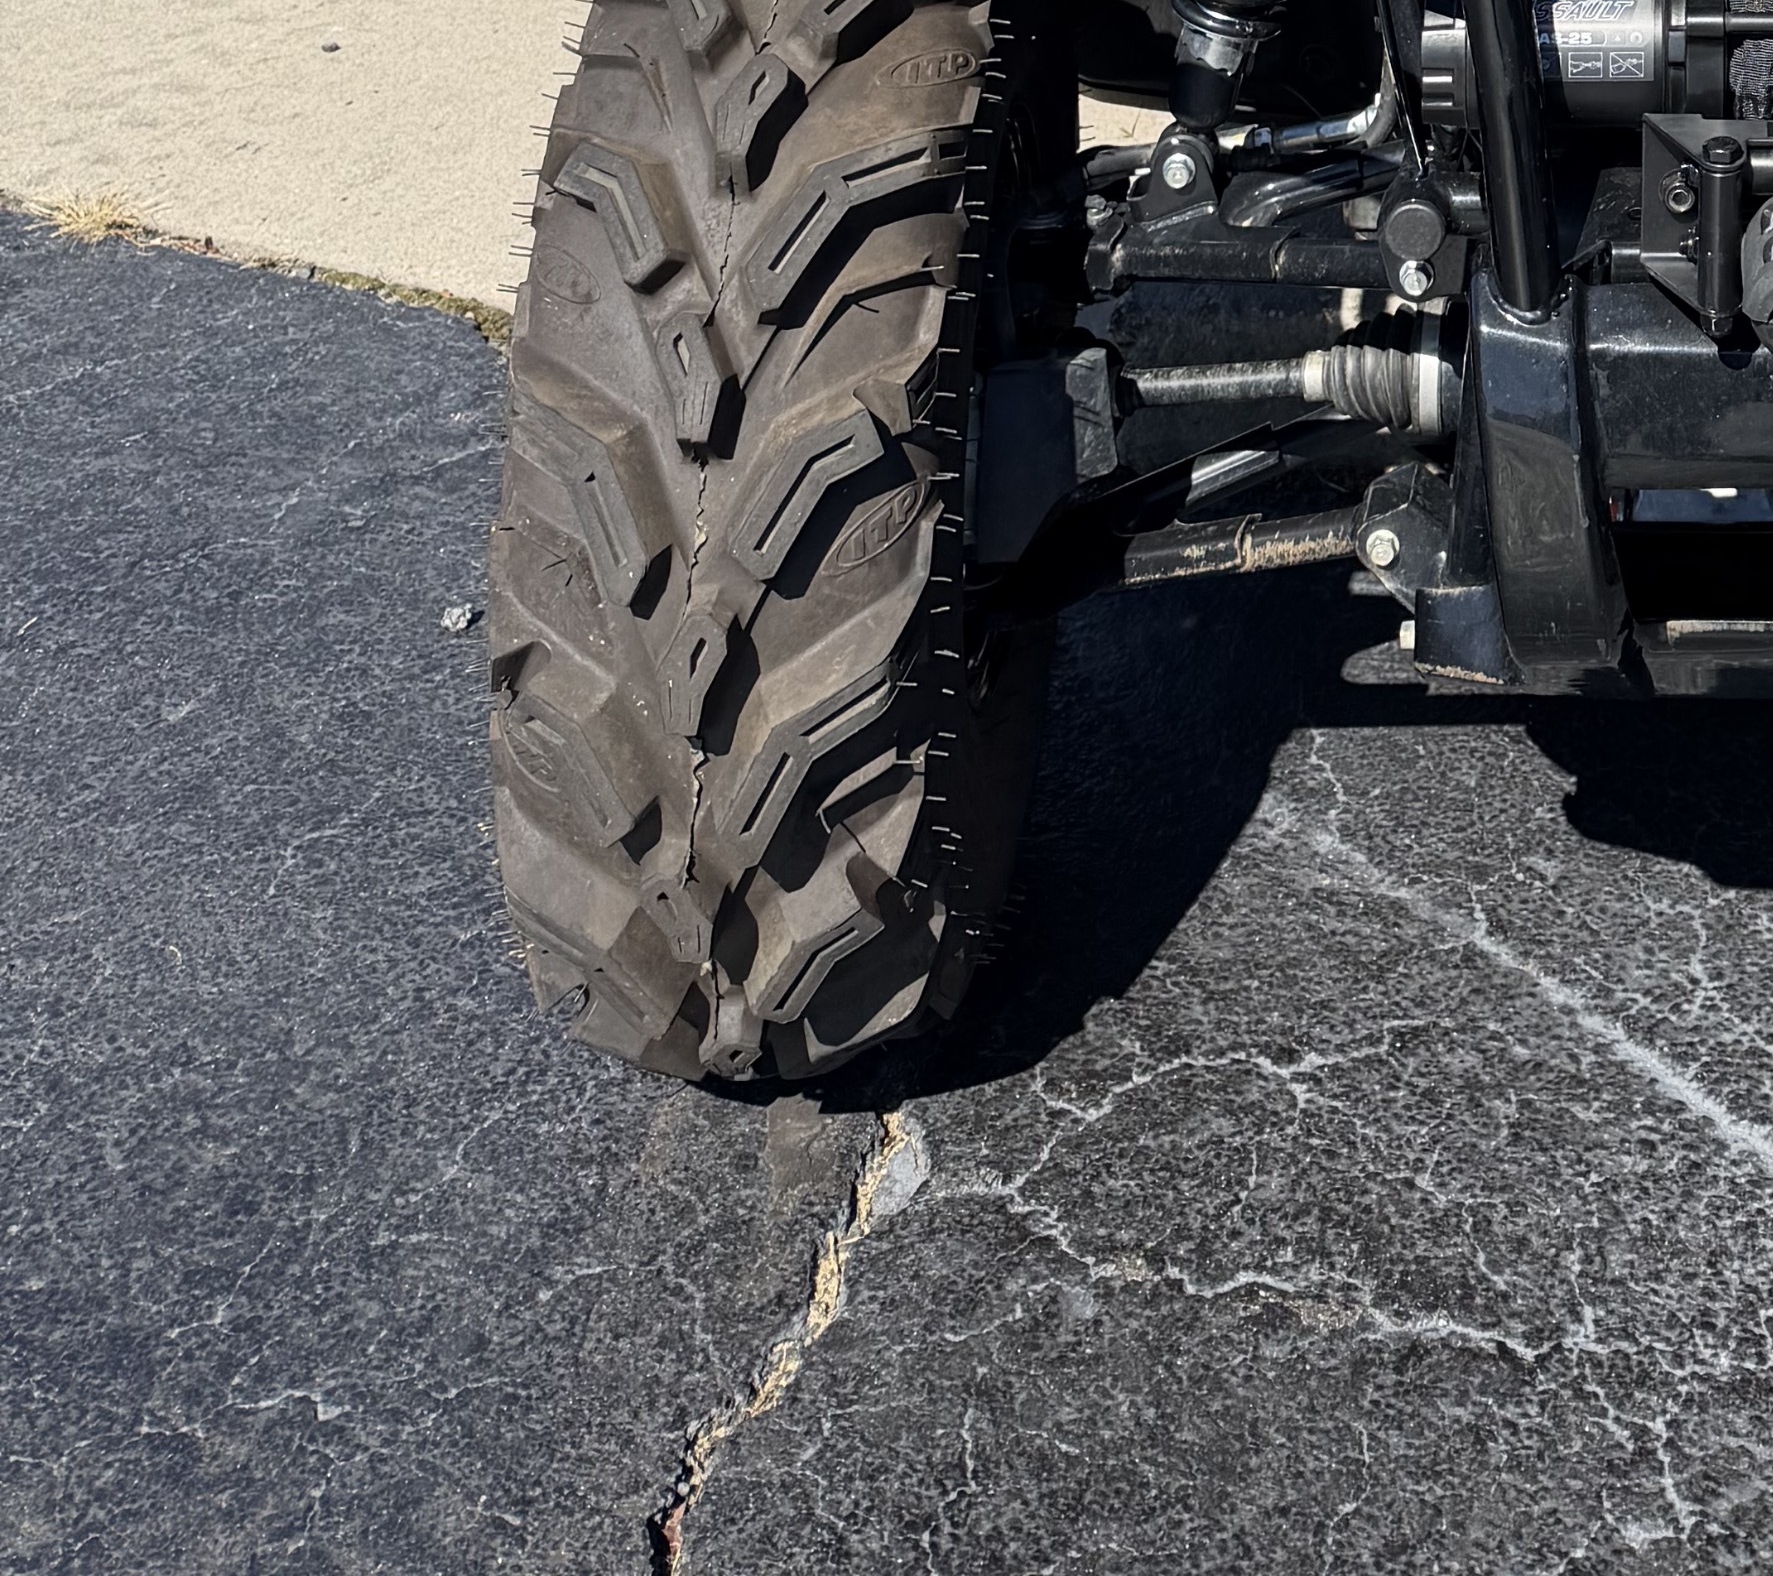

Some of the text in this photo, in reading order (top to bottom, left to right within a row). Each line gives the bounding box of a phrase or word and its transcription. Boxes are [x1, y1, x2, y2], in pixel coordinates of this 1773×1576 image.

[1533, 0, 1635, 22] SSAULT
[904, 52, 969, 84] ITP
[851, 486, 918, 560] ITP
